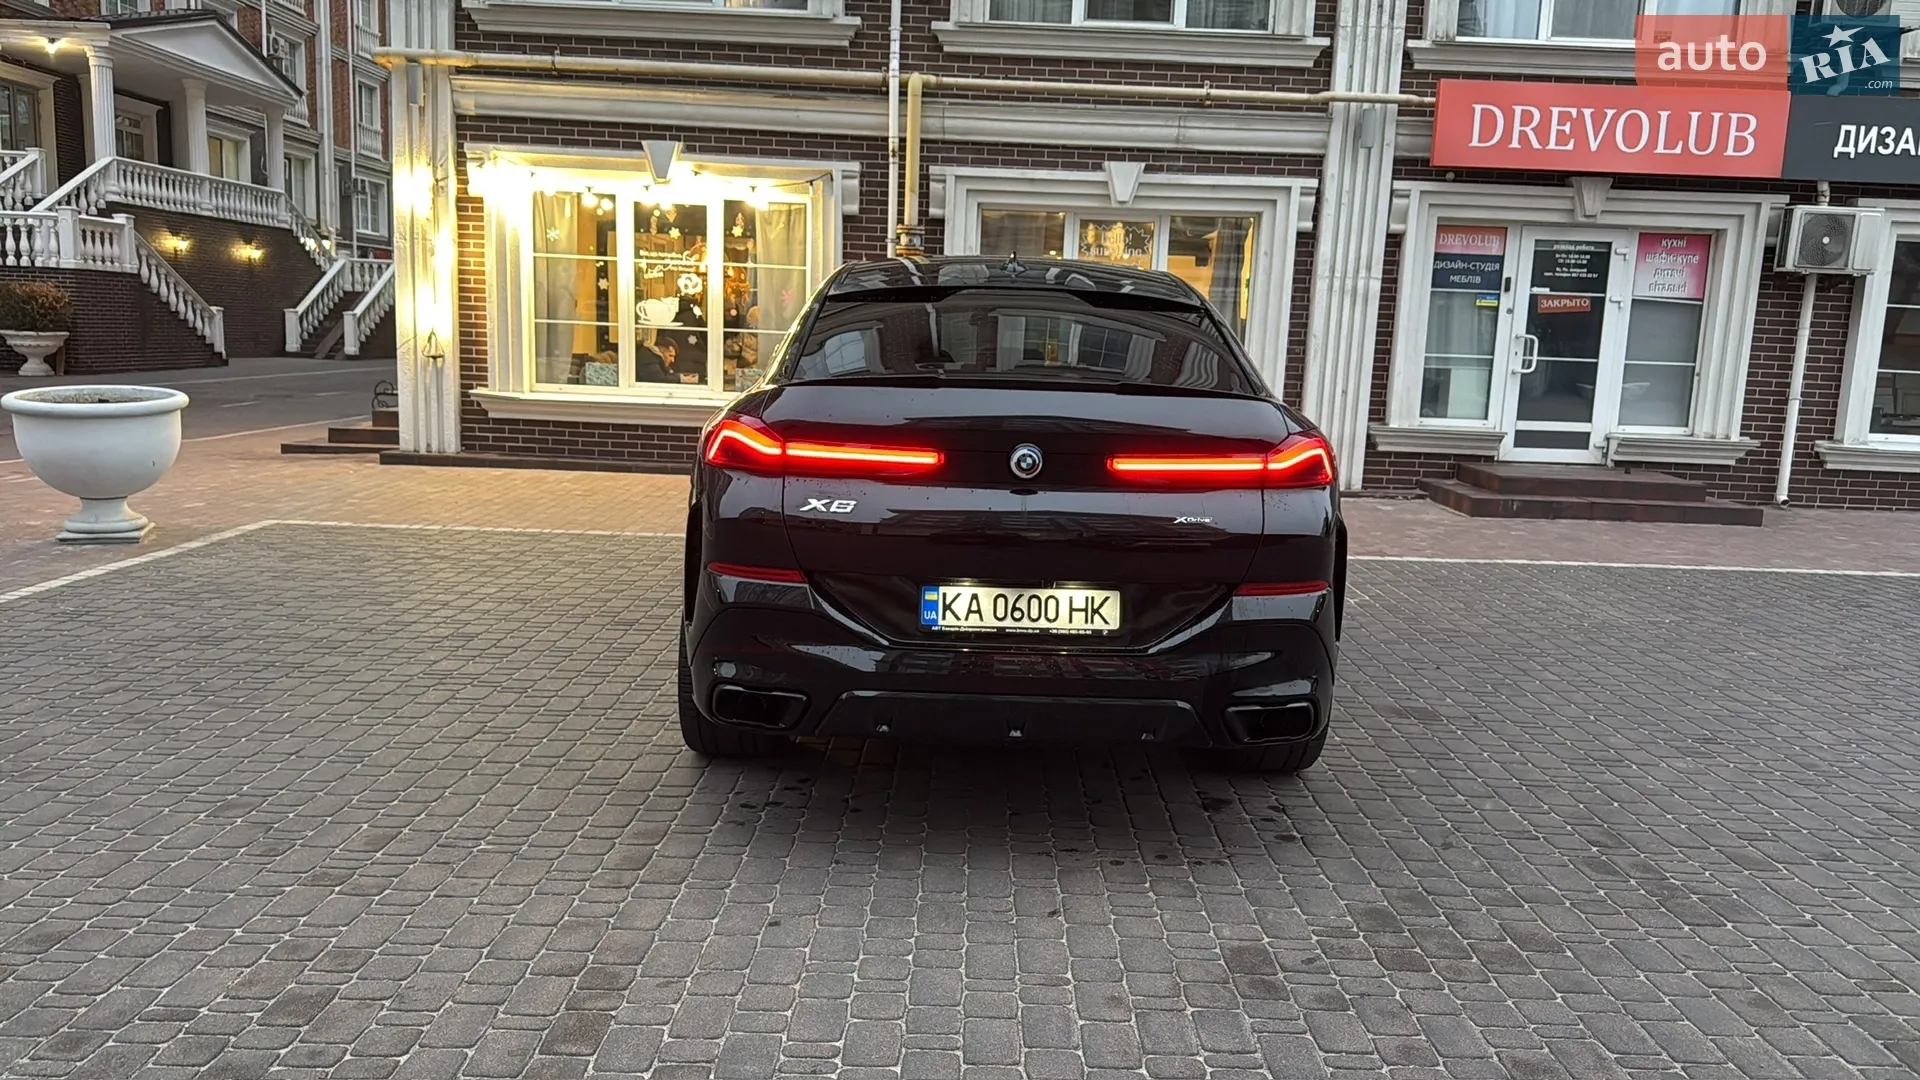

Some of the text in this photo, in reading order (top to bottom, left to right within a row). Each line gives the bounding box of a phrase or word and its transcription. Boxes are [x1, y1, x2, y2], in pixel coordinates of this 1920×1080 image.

[1469, 103, 1758, 157] DREVOLUB
[1833, 124, 1920, 159] ДИЗА
[1440, 233, 1500, 247] DREVOLUB
[1661, 237, 1687, 249] кухні
[1433, 260, 1500, 271] ДИЗАЙН-СТУДІЯ
[1449, 275, 1482, 284] МЕБЛІВ
[1541, 298, 1589, 308] ЗАКРЫТО
[799, 498, 857, 513] X6
[942, 592, 1111, 625] KA 0600 HK
[924, 611, 937, 620] UA
